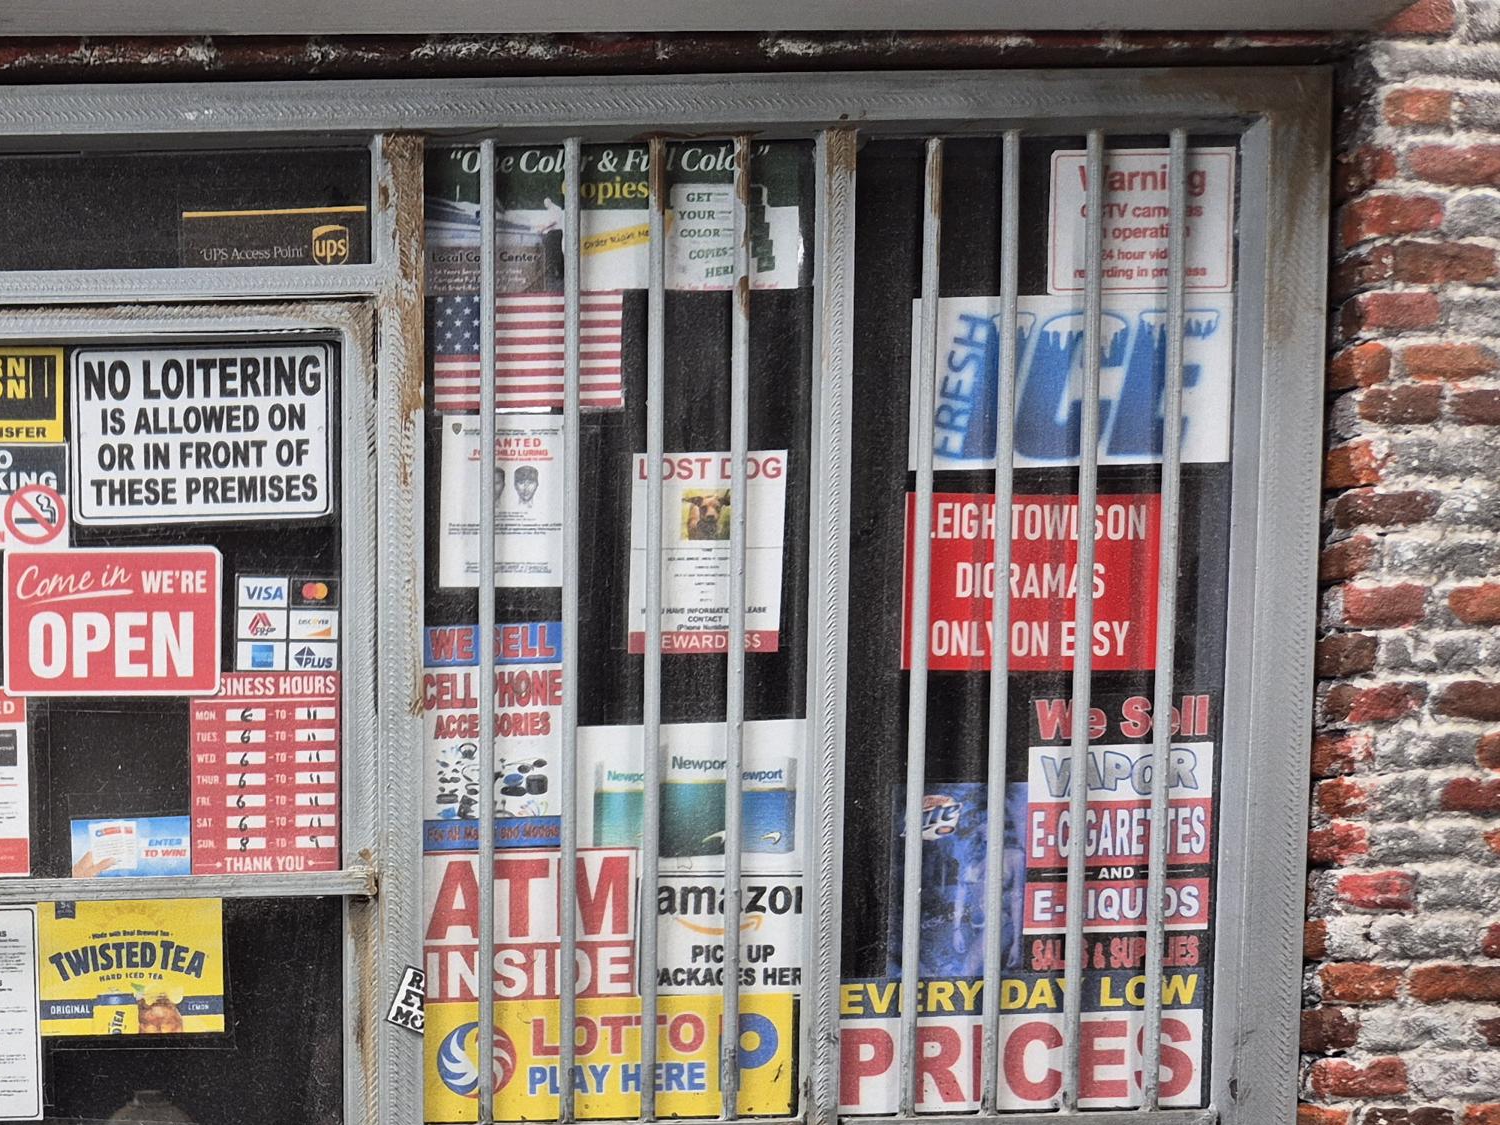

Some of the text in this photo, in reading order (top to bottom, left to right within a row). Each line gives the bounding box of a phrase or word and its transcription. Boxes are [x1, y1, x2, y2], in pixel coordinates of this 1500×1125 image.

[596, 150, 618, 172] &
[686, 192, 713, 202] GET
[679, 211, 716, 220] YOUR
[680, 229, 720, 238] COLOR
[231, 247, 271, 260] Access
[314, 239, 347, 263] ups
[431, 250, 462, 262] Local
[689, 248, 729, 260] COPIES
[1117, 248, 1145, 260] hour
[1137, 266, 1148, 277] in
[83, 353, 322, 402] NO LOITERING
[934, 313, 998, 460] FRESH
[101, 402, 306, 436] IS ALLOWED ON
[97, 438, 310, 471] OR IN FRONT OF
[91, 473, 318, 507] THESE PREMISES
[15, 563, 207, 602] Come in WE'RE
[245, 586, 283, 600] VISA
[28, 611, 195, 679] OPEN
[430, 628, 475, 661] WE
[662, 634, 726, 649] EWARD
[1011, 621, 1049, 657] ON
[303, 657, 333, 668] PLUS
[279, 676, 335, 695] HOURS
[423, 673, 479, 710] CELL
[1034, 695, 1210, 740] We Sell
[240, 729, 251, 744] 6
[240, 752, 249, 767] 6
[239, 773, 246, 788] 6
[1041, 748, 1199, 798] VAPOR
[236, 794, 245, 809] 6
[238, 816, 248, 831] 6
[148, 838, 182, 846] ENTER
[239, 837, 249, 852] 8
[224, 856, 304, 872] THANK YOU
[1098, 867, 1134, 880] AND
[425, 856, 630, 940] ATM
[48, 941, 156, 982] TWISTED
[160, 940, 206, 979] TEA
[747, 945, 775, 963] UP
[100, 973, 122, 982] HARD
[426, 945, 631, 999] INSIDE
[839, 974, 1199, 1014] EVERY DAY LOW
[51, 1005, 90, 1014] ORIGINAL
[531, 1012, 707, 1057] LOTTO
[839, 1017, 1194, 1107] PRICES
[528, 1061, 707, 1094] PLAY HERE
